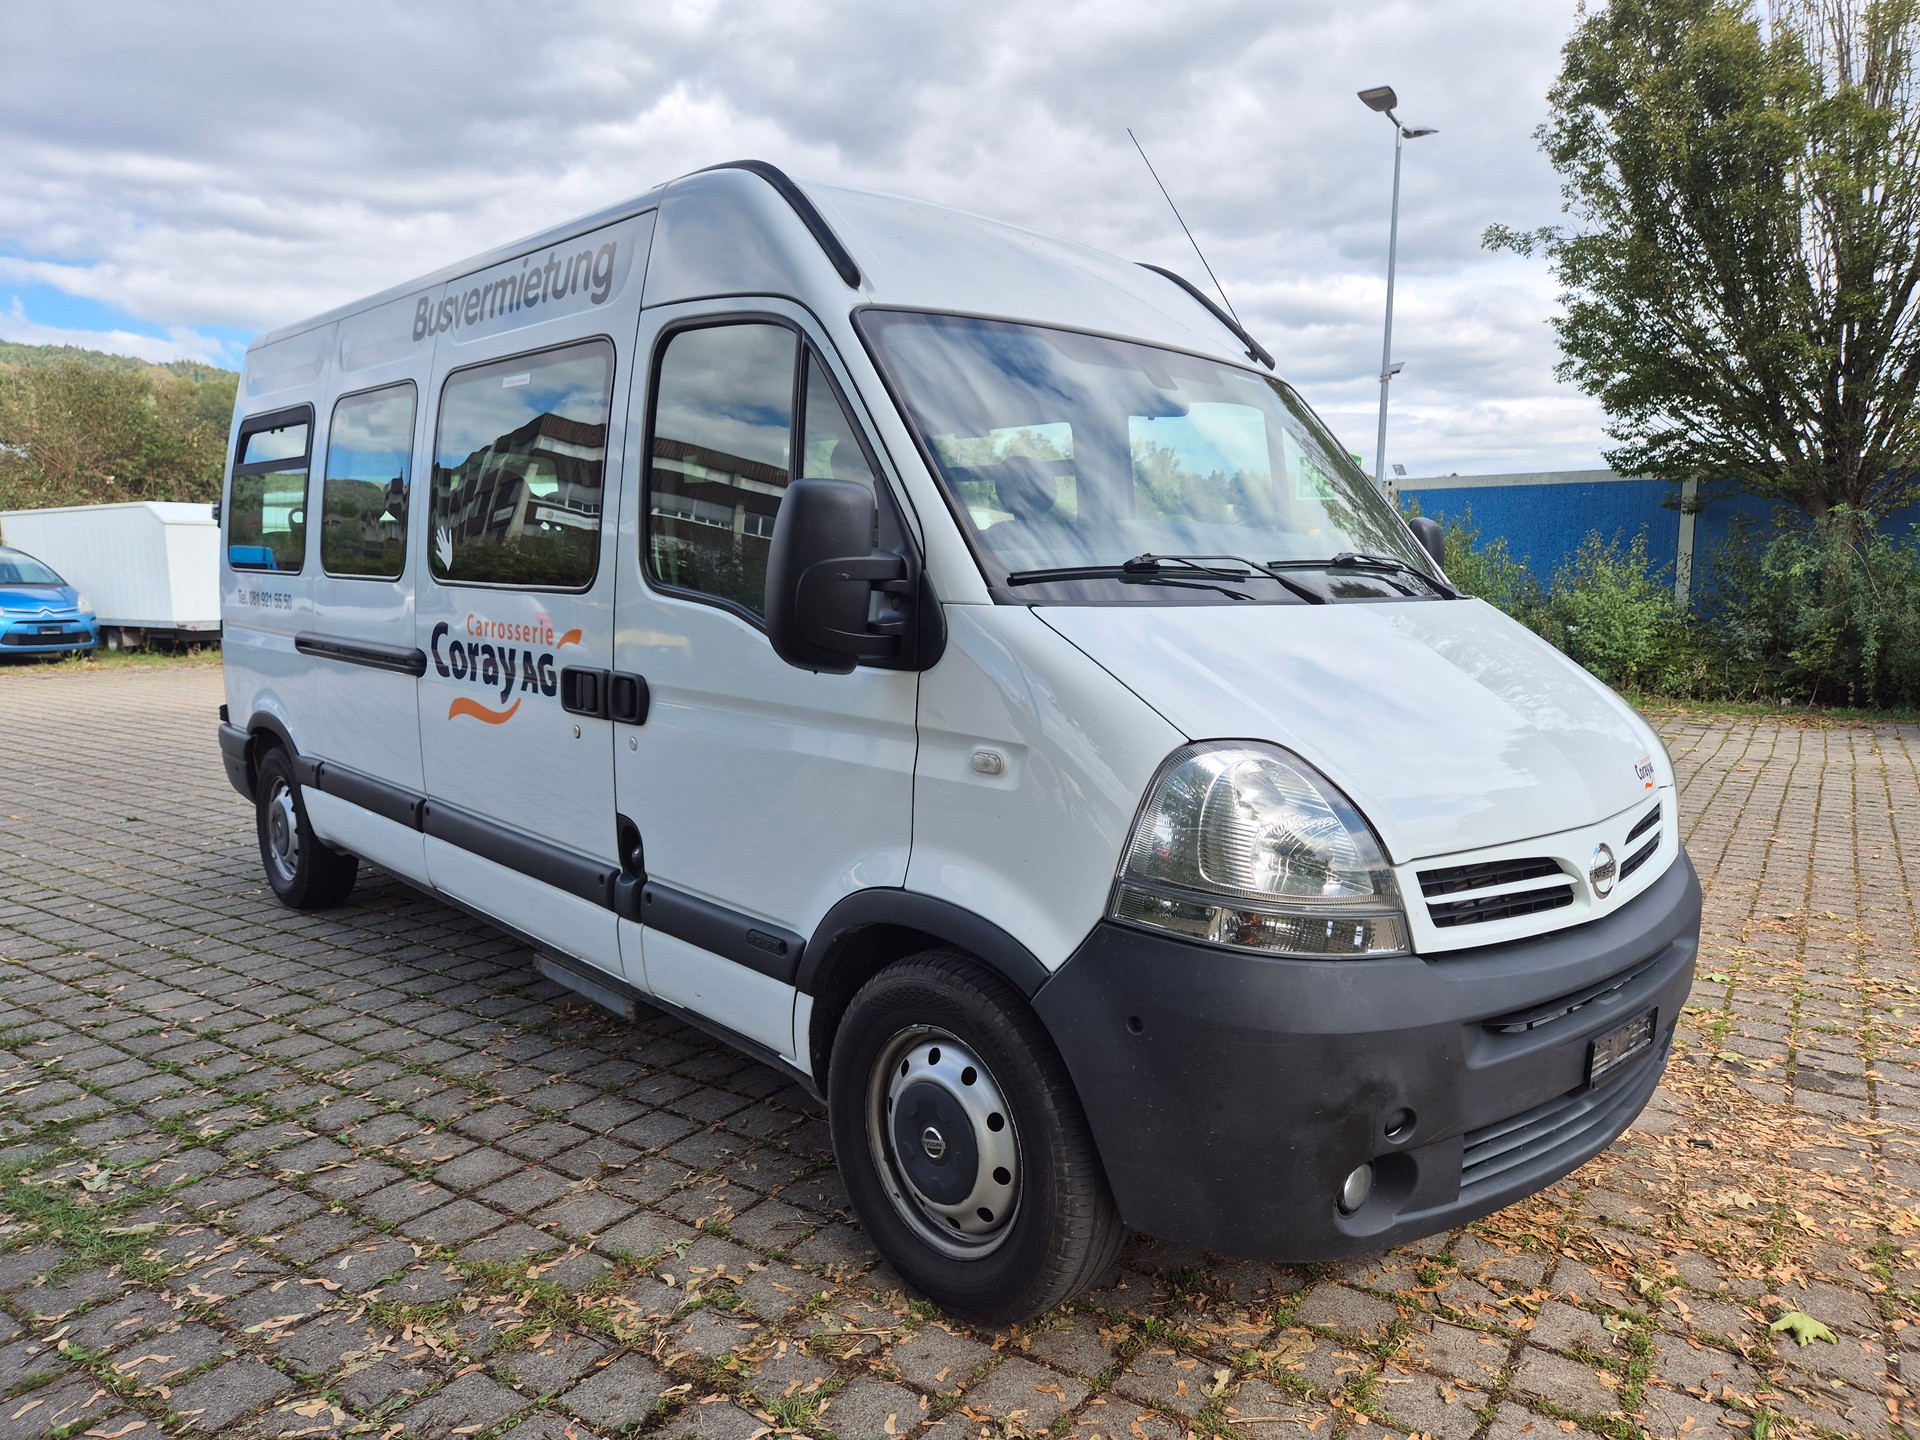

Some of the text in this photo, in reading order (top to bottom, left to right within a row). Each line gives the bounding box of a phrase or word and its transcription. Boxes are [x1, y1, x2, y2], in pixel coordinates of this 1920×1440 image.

[412, 241, 617, 342] Busvermietung
[249, 590, 260, 606] 081
[261, 591, 272, 608] 921
[274, 592, 283, 609] 55
[284, 593, 292, 610] 50
[466, 613, 554, 646] Carrosserie
[431, 621, 557, 705] Coray AG
